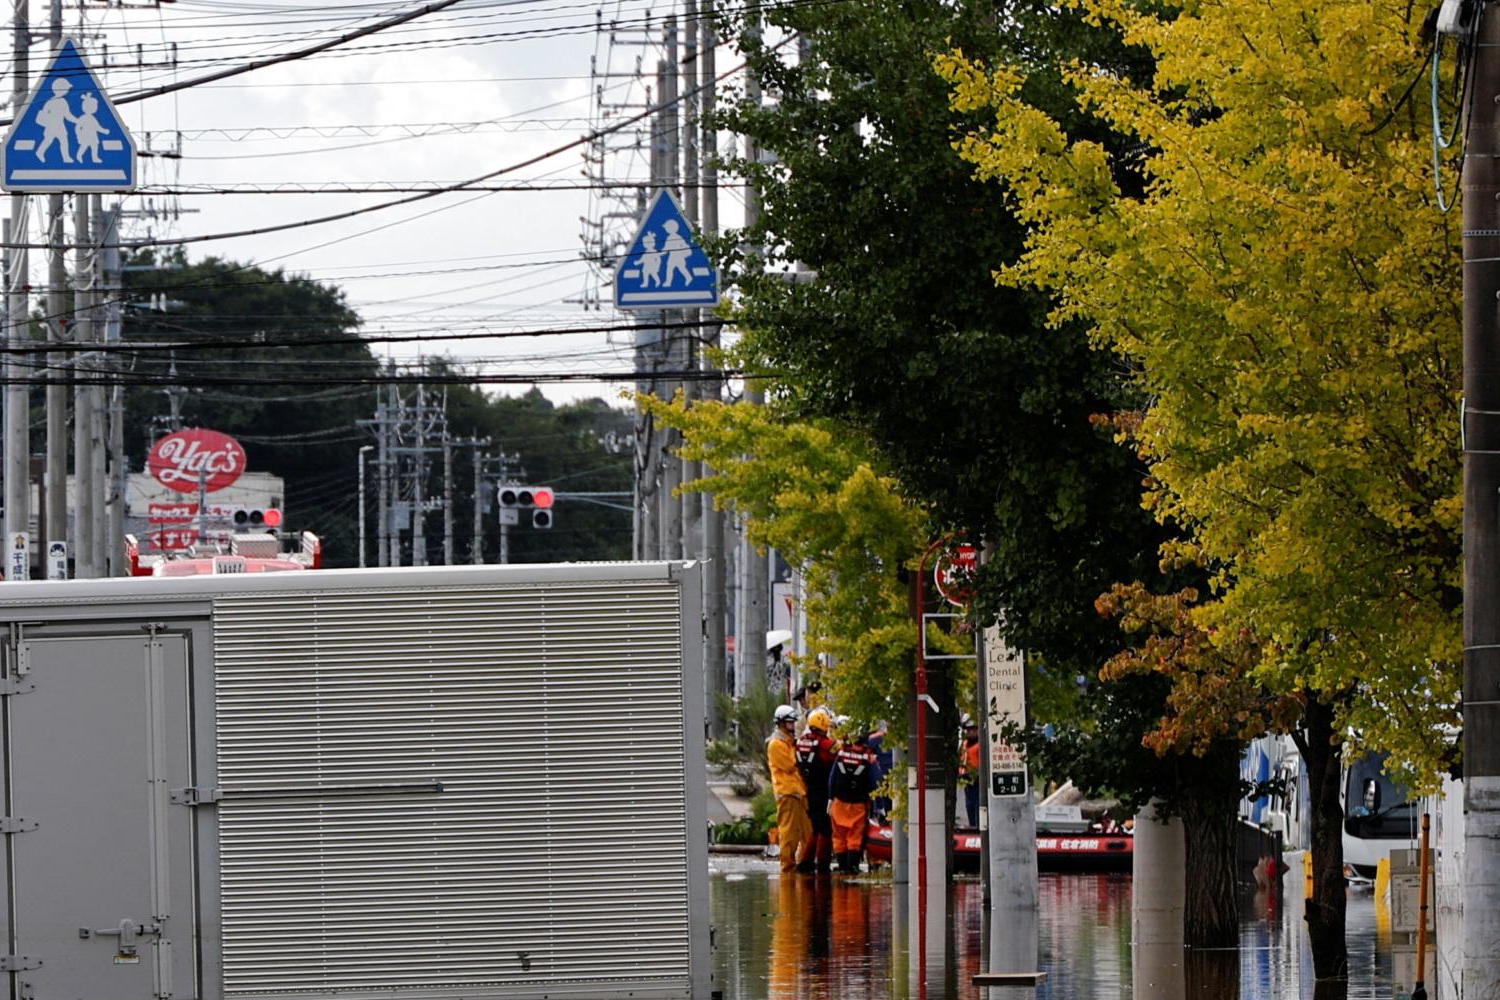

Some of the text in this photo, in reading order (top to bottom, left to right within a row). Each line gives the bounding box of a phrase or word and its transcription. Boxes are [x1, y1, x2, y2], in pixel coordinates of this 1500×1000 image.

[158, 437, 240, 483] Yac's
[989, 666, 1021, 677] Dental
[989, 681, 1017, 691] Clinic
